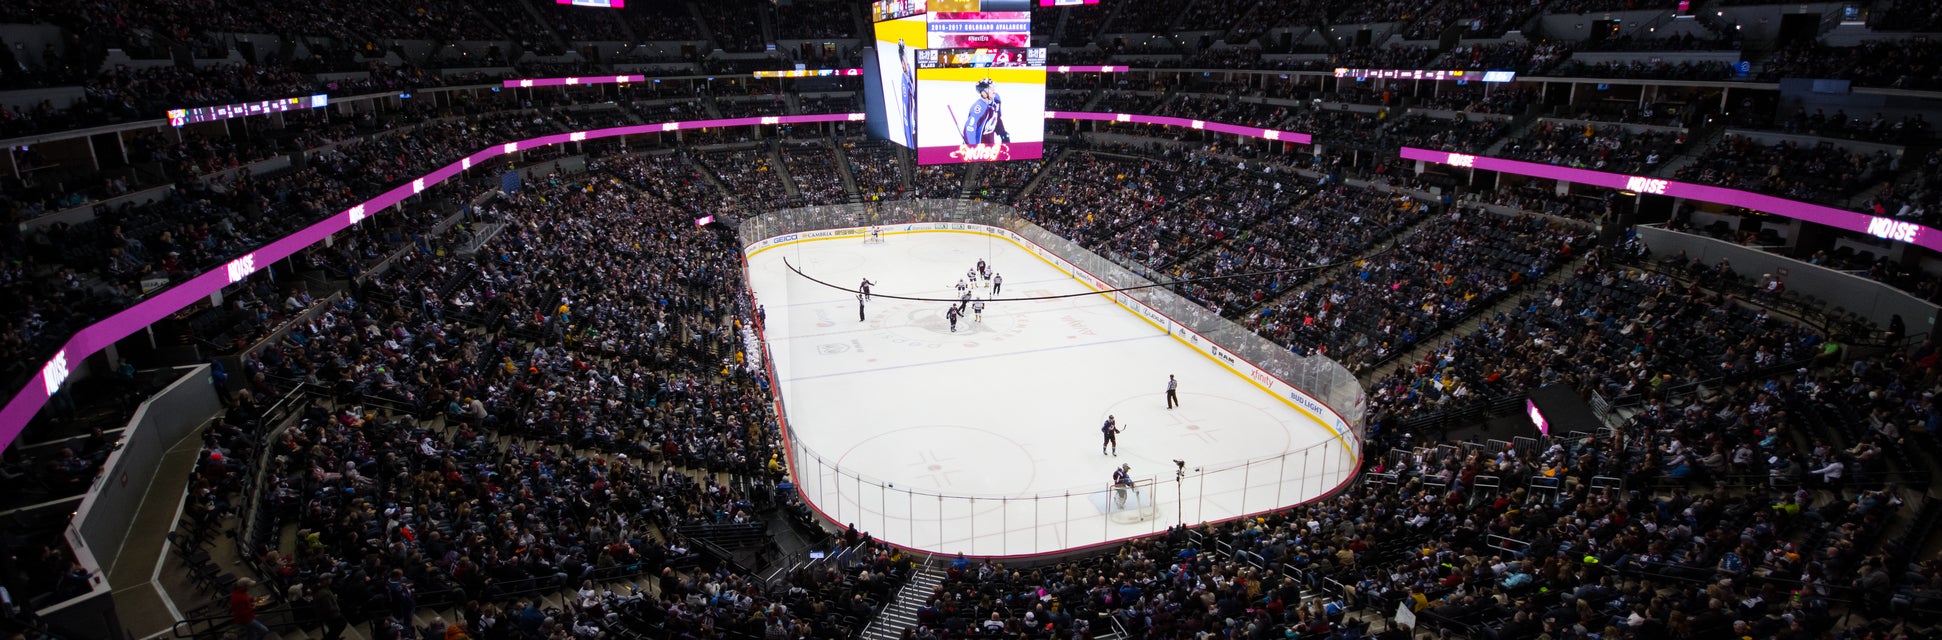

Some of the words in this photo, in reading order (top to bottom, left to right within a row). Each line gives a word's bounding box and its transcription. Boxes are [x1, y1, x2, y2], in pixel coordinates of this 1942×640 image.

[1447, 152, 1474, 168] NOISE
[1626, 176, 1668, 195] NOISE
[774, 234, 798, 244] GEICO
[1867, 216, 1920, 244] NOISE
[228, 252, 256, 284] NOISE
[1218, 350, 1235, 364] RAM
[43, 349, 69, 396] NOISE
[1250, 368, 1274, 388] xfinity
[1290, 392, 1304, 405] BUD
[1304, 401, 1324, 416] LIGHT
